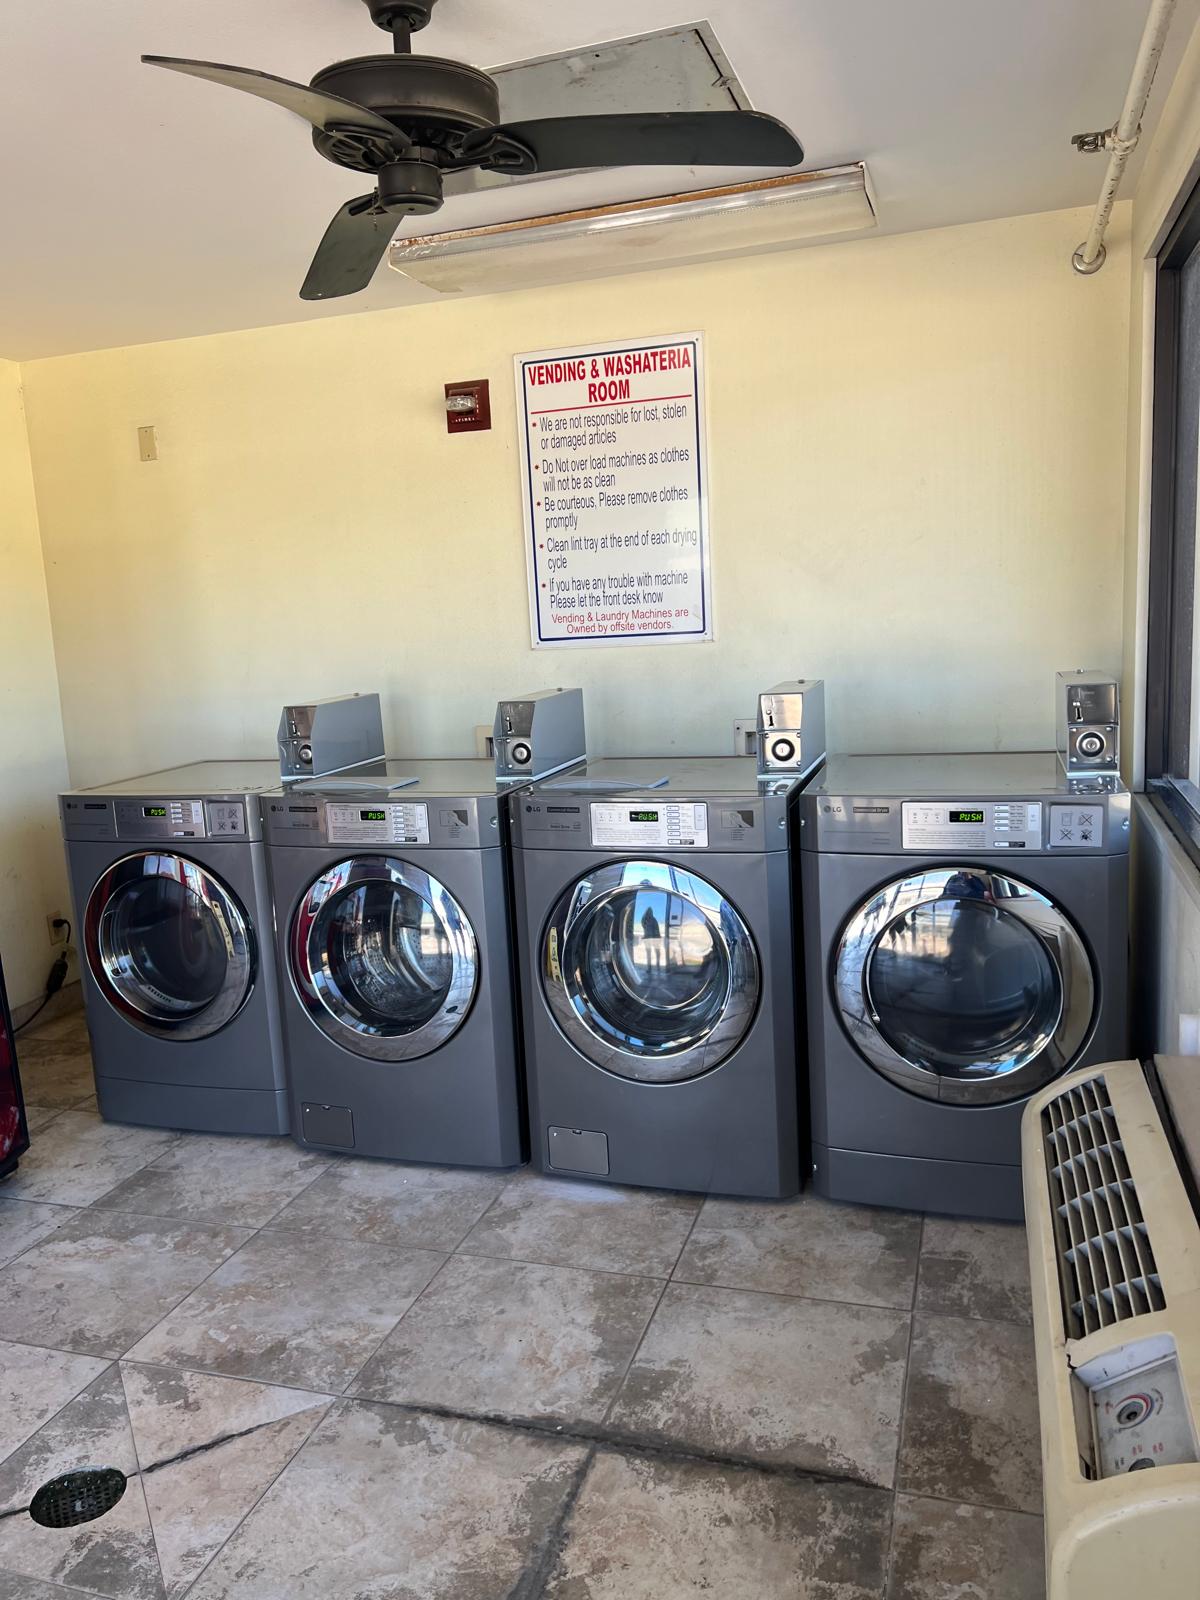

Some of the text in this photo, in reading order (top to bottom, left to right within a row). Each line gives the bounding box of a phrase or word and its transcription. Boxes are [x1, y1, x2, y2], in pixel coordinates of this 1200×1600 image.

[528, 347, 691, 386] VENDING & WASHATERIA
[588, 379, 630, 403] ROOM
[539, 403, 687, 432] We are not responsible for lost, stolen
[541, 427, 616, 450] or damaged articles
[542, 447, 689, 474] Do Not over load machines as clothes
[543, 473, 615, 492] will not be as clean
[544, 497, 555, 511] Be
[599, 491, 626, 507] Please
[628, 492, 657, 504] remove
[659, 486, 688, 502] clothes
[546, 512, 578, 531] promptly
[547, 528, 697, 553] Clean lint tray at the end of each drying
[547, 555, 568, 572] cycle
[550, 570, 688, 595] If you have any trouble with machine
[551, 590, 663, 608] Please let the front desk know
[552, 609, 689, 624] Vending & Laundry Machines are
[567, 624, 596, 633] Owned
[598, 623, 607, 634] by
[610, 621, 635, 632] offsite
[151, 808, 166, 816] PUSH
